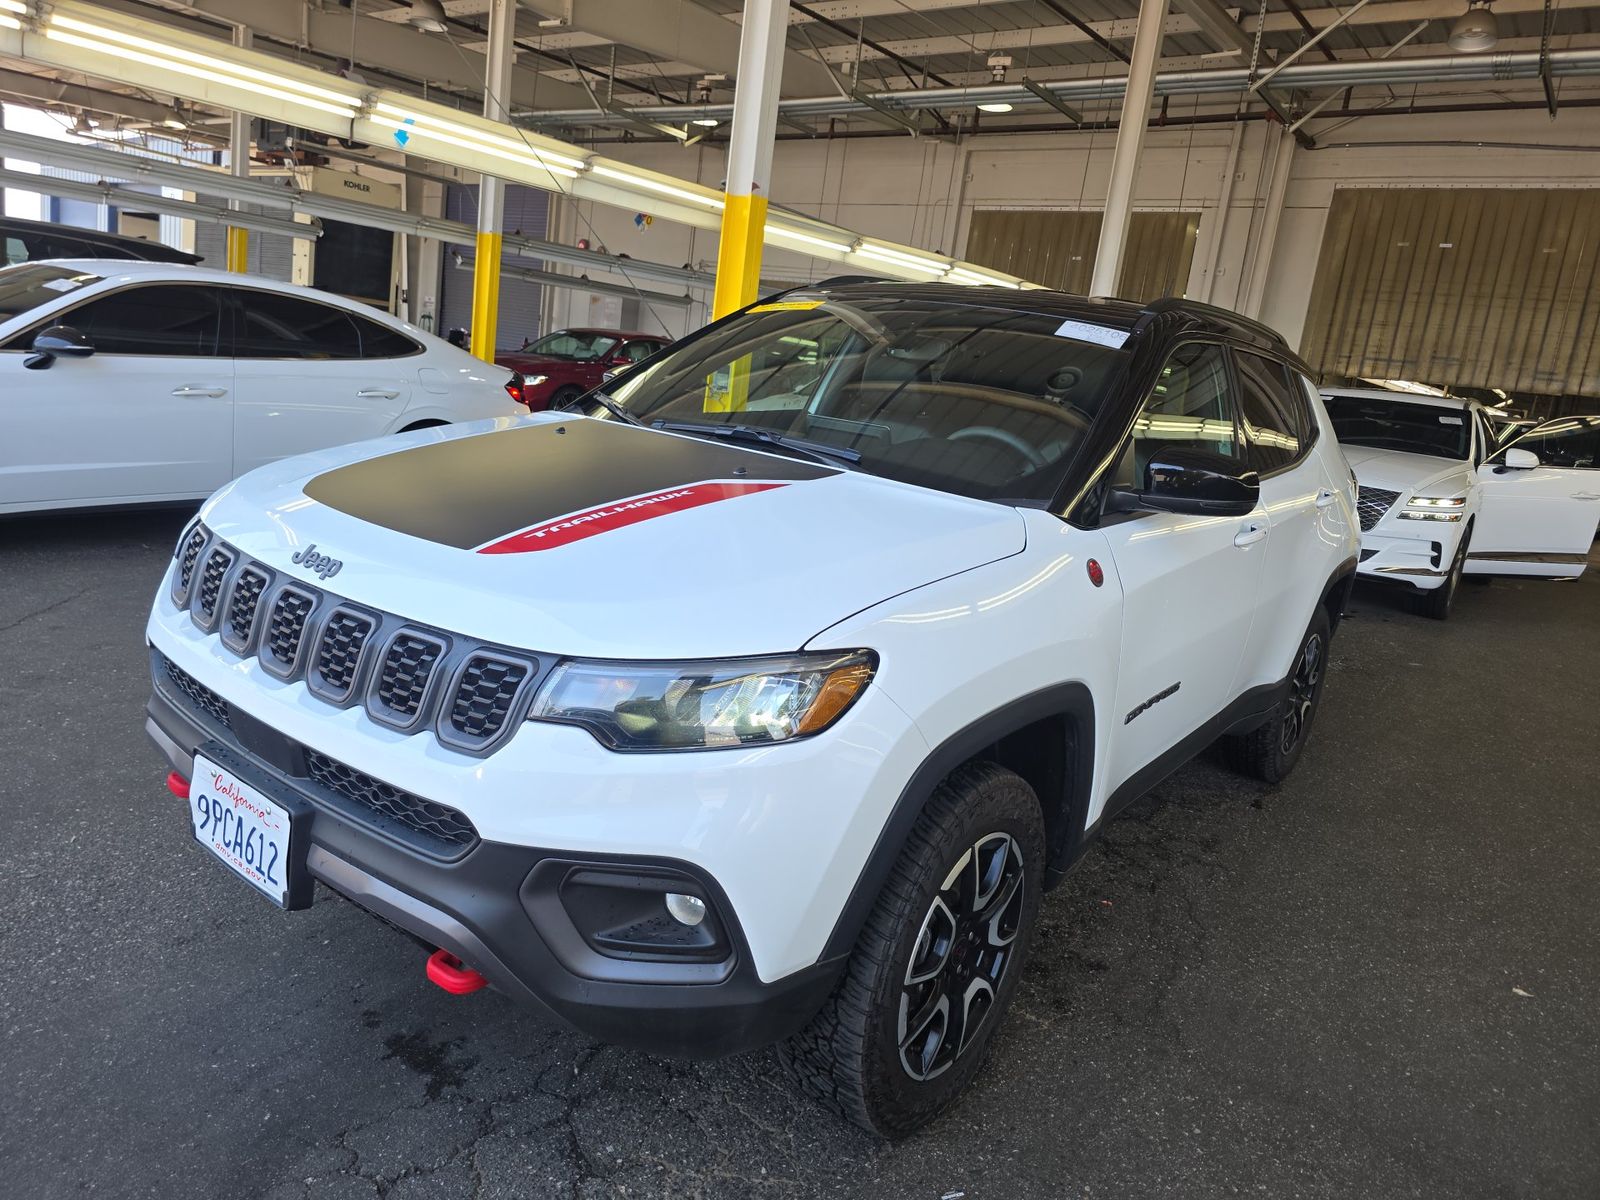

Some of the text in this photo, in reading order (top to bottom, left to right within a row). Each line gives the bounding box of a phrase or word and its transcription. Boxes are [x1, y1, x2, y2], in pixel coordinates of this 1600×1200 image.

[343, 179, 371, 192] KOHLER
[523, 489, 695, 539] TRAILHAWK
[291, 543, 343, 580] Jeep
[214, 774, 271, 828] California
[197, 794, 279, 886] 9PCA612
[215, 841, 262, 882] dmv.ca.gov
